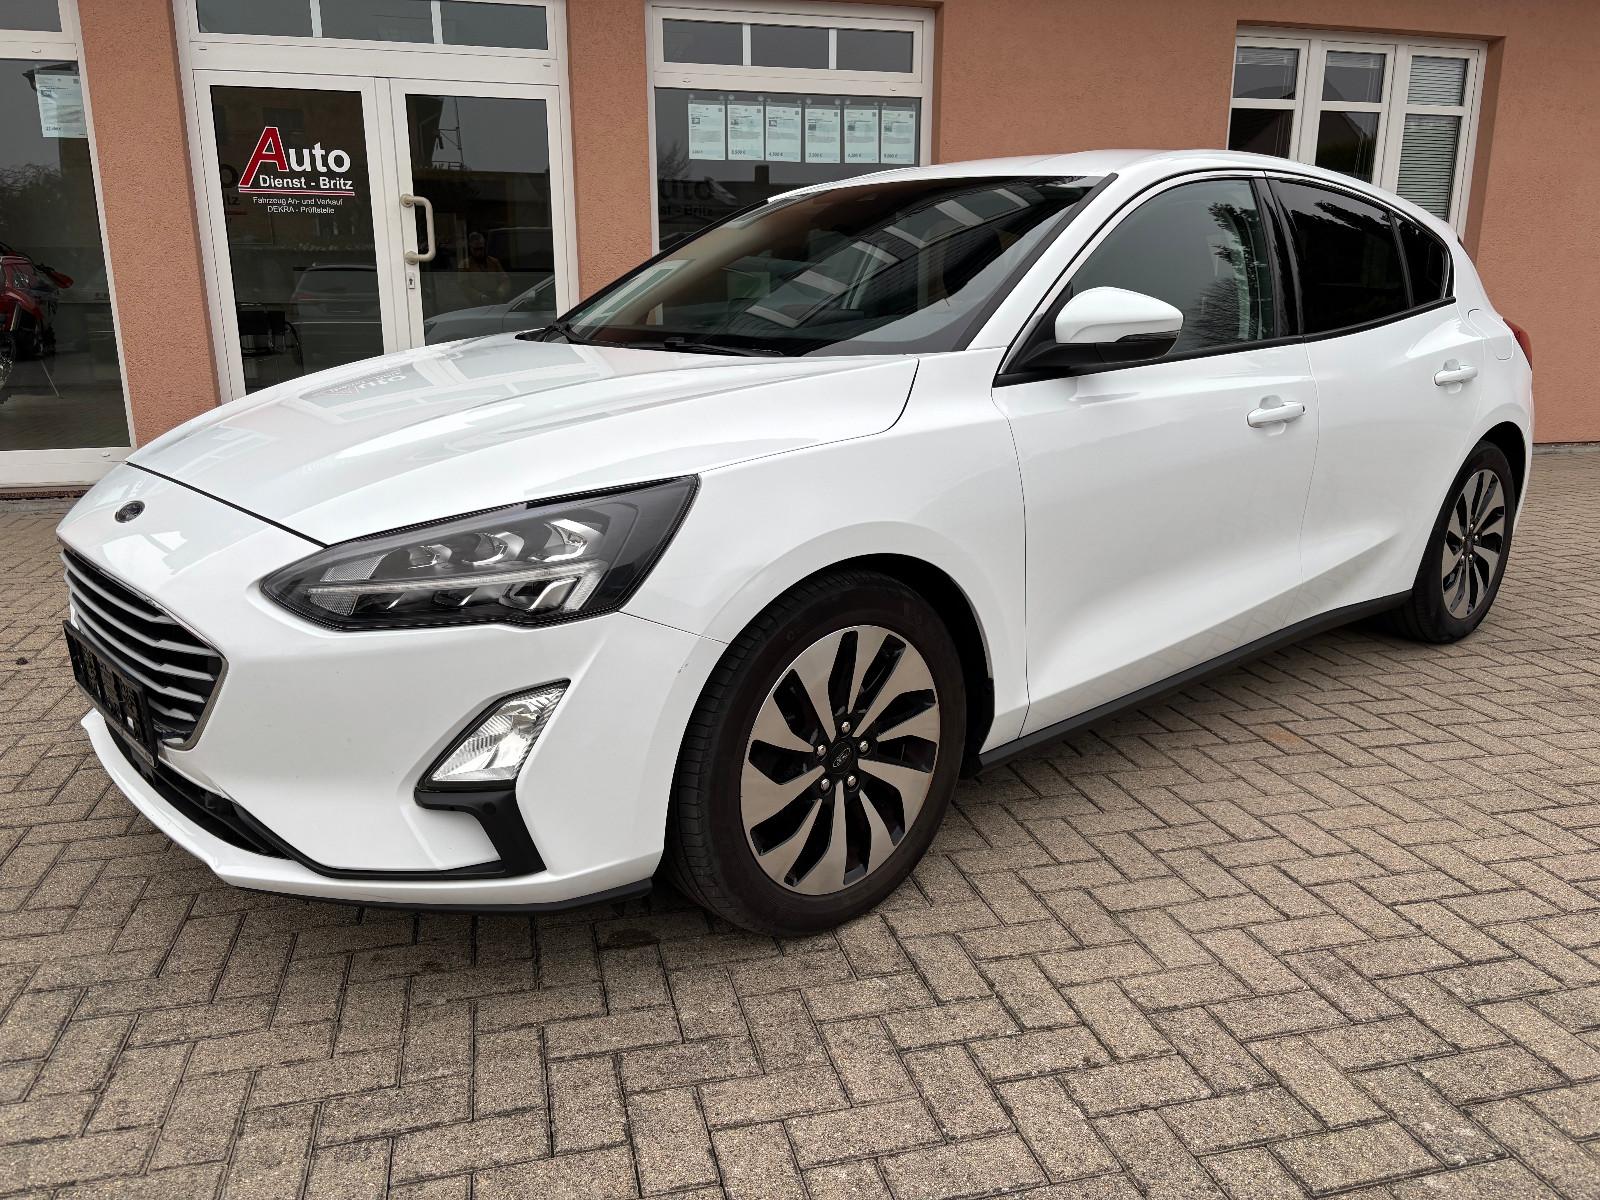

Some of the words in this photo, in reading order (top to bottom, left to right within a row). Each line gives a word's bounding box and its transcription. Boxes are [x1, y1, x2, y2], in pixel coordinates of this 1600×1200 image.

[238, 126, 351, 187] Auto
[259, 175, 307, 188] Dienst
[319, 177, 353, 189] Britz
[253, 197, 286, 205] Fahrzeug
[317, 198, 343, 206] Verkauf
